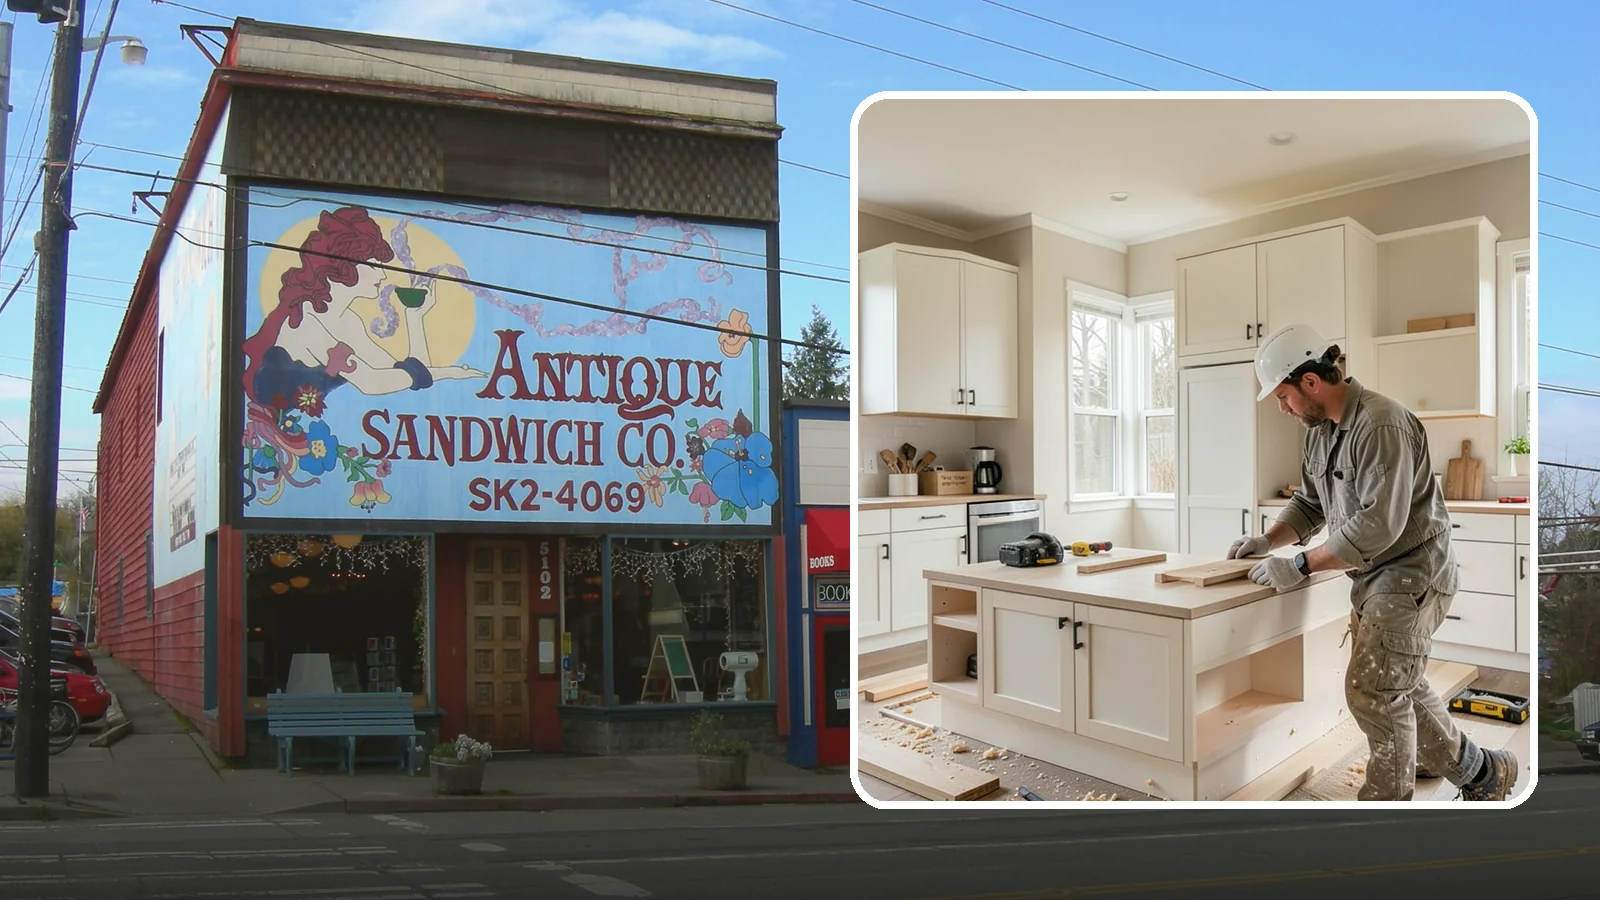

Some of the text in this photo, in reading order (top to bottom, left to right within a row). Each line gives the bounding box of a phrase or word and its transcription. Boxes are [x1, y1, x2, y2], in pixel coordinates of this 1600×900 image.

[476, 329, 723, 420] ANTIQUE
[361, 408, 685, 468] SANDWICH CO.
[468, 477, 645, 513] SK2-4069
[540, 542, 551, 600] 5102
[809, 554, 835, 569] BOOKS
